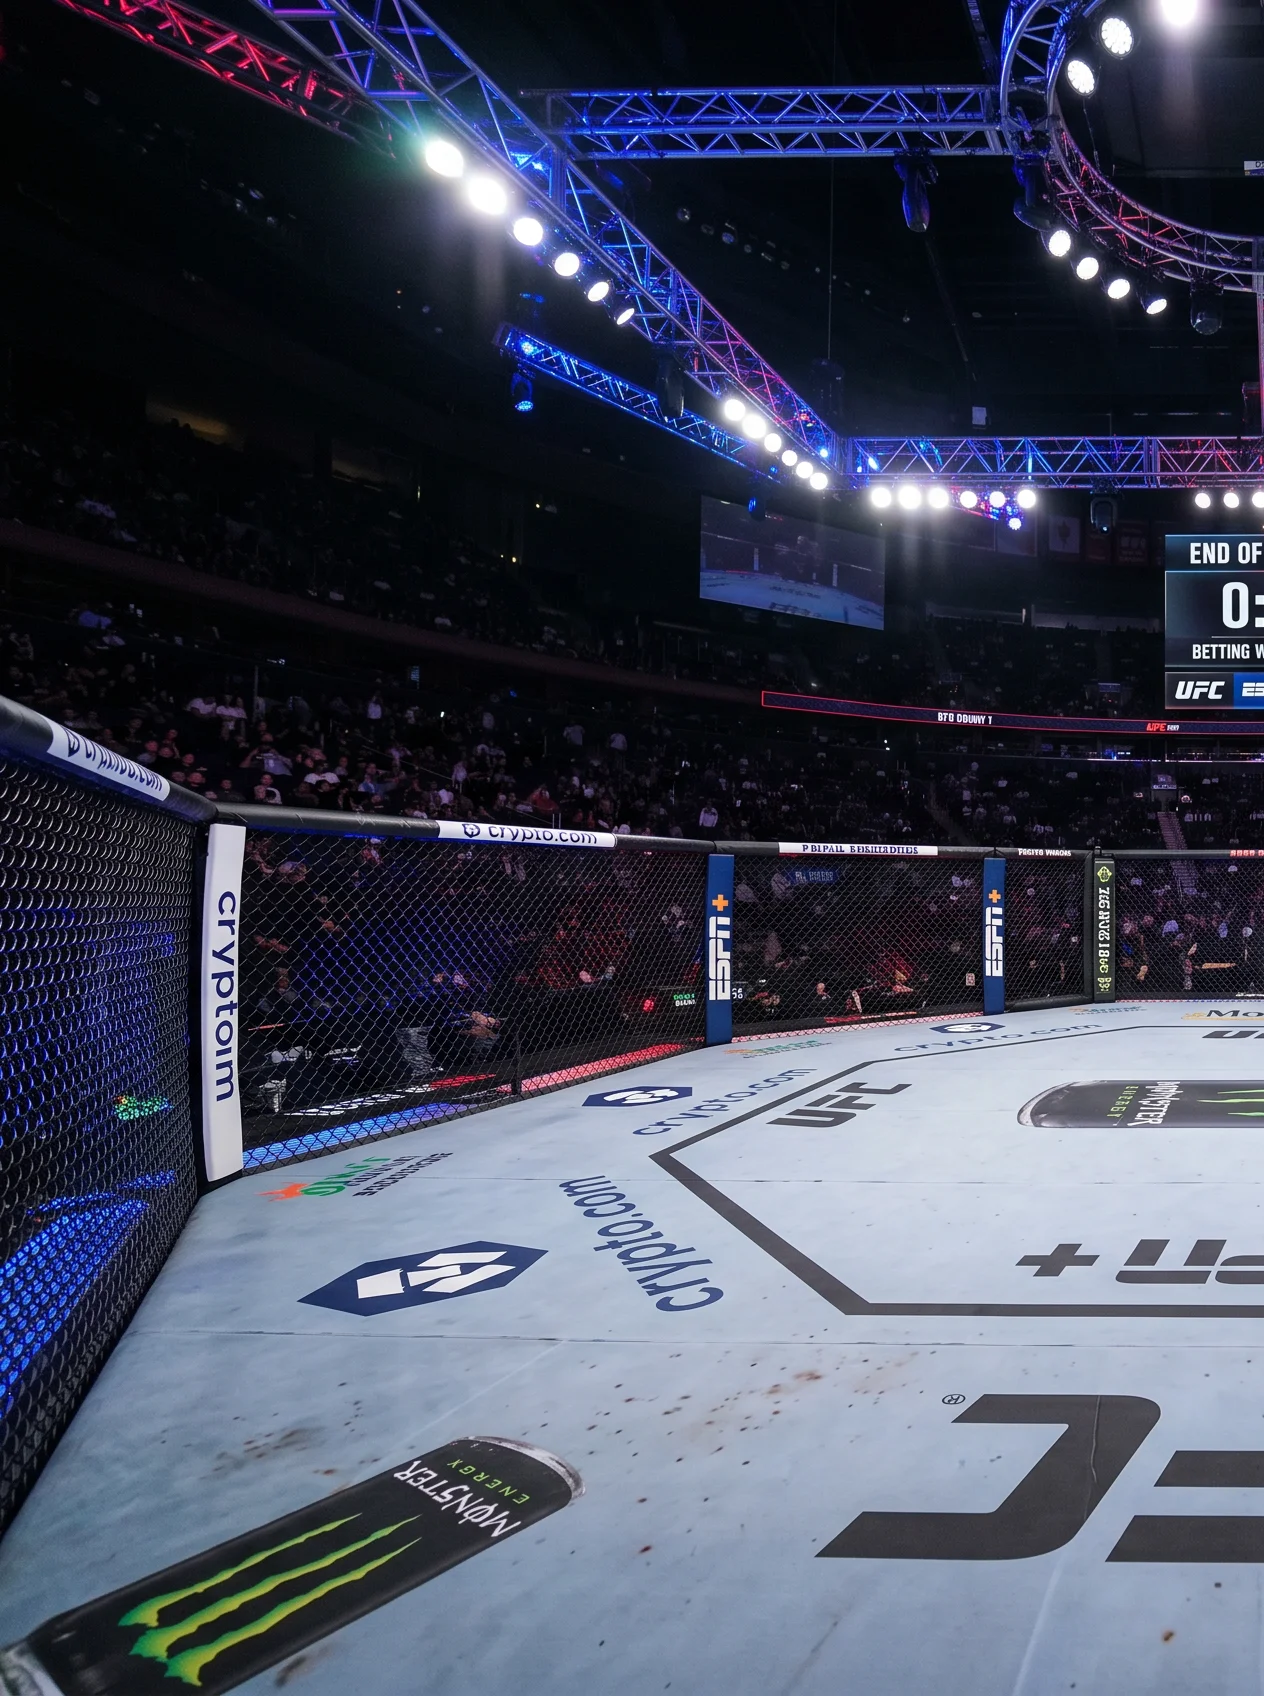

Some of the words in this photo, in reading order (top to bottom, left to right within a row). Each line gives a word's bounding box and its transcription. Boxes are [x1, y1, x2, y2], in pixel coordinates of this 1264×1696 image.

[1190, 542, 1230, 564] END
[1237, 542, 1263, 564] OF
[1192, 644, 1251, 660] BETTING
[1174, 680, 1226, 699] UFC
[488, 825, 598, 845] crypto.com
[632, 1068, 818, 1136] crypto.com
[766, 1081, 913, 1128] UFC
[558, 1175, 724, 1312] crypto.com
